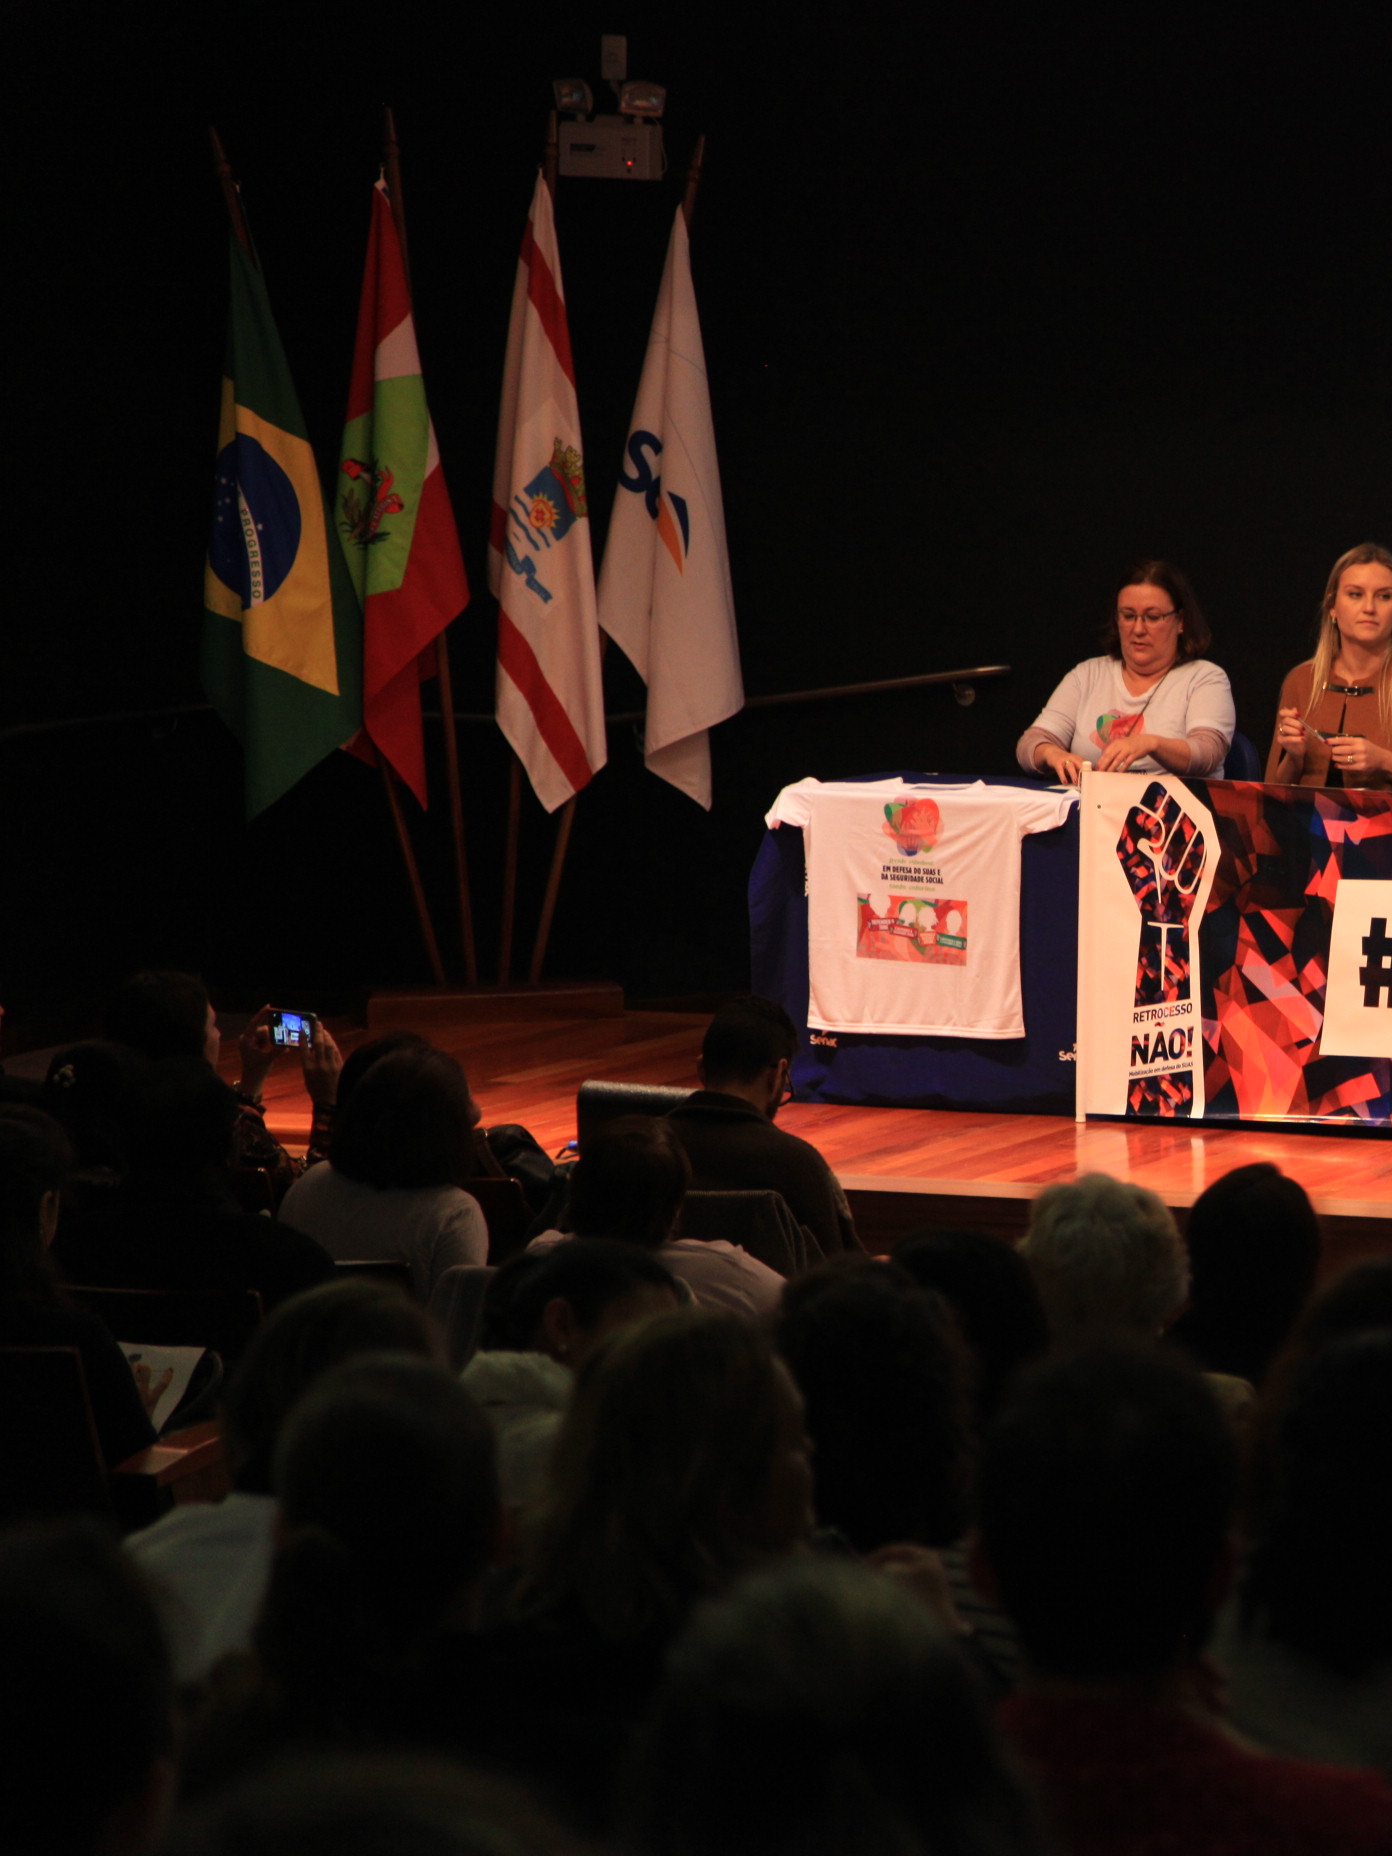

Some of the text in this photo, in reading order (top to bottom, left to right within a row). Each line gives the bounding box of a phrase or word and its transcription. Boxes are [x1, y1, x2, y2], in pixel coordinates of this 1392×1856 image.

[240, 508, 262, 599] PROGRESSO
[889, 874, 924, 883] SEGURIDADE
[925, 876, 944, 885] SOCIAL
[892, 865, 912, 874] DEFESA
[922, 868, 936, 876] SUAS
[1132, 1002, 1194, 1024] RETROCESSO
[1130, 1021, 1195, 1068] NÃO!
